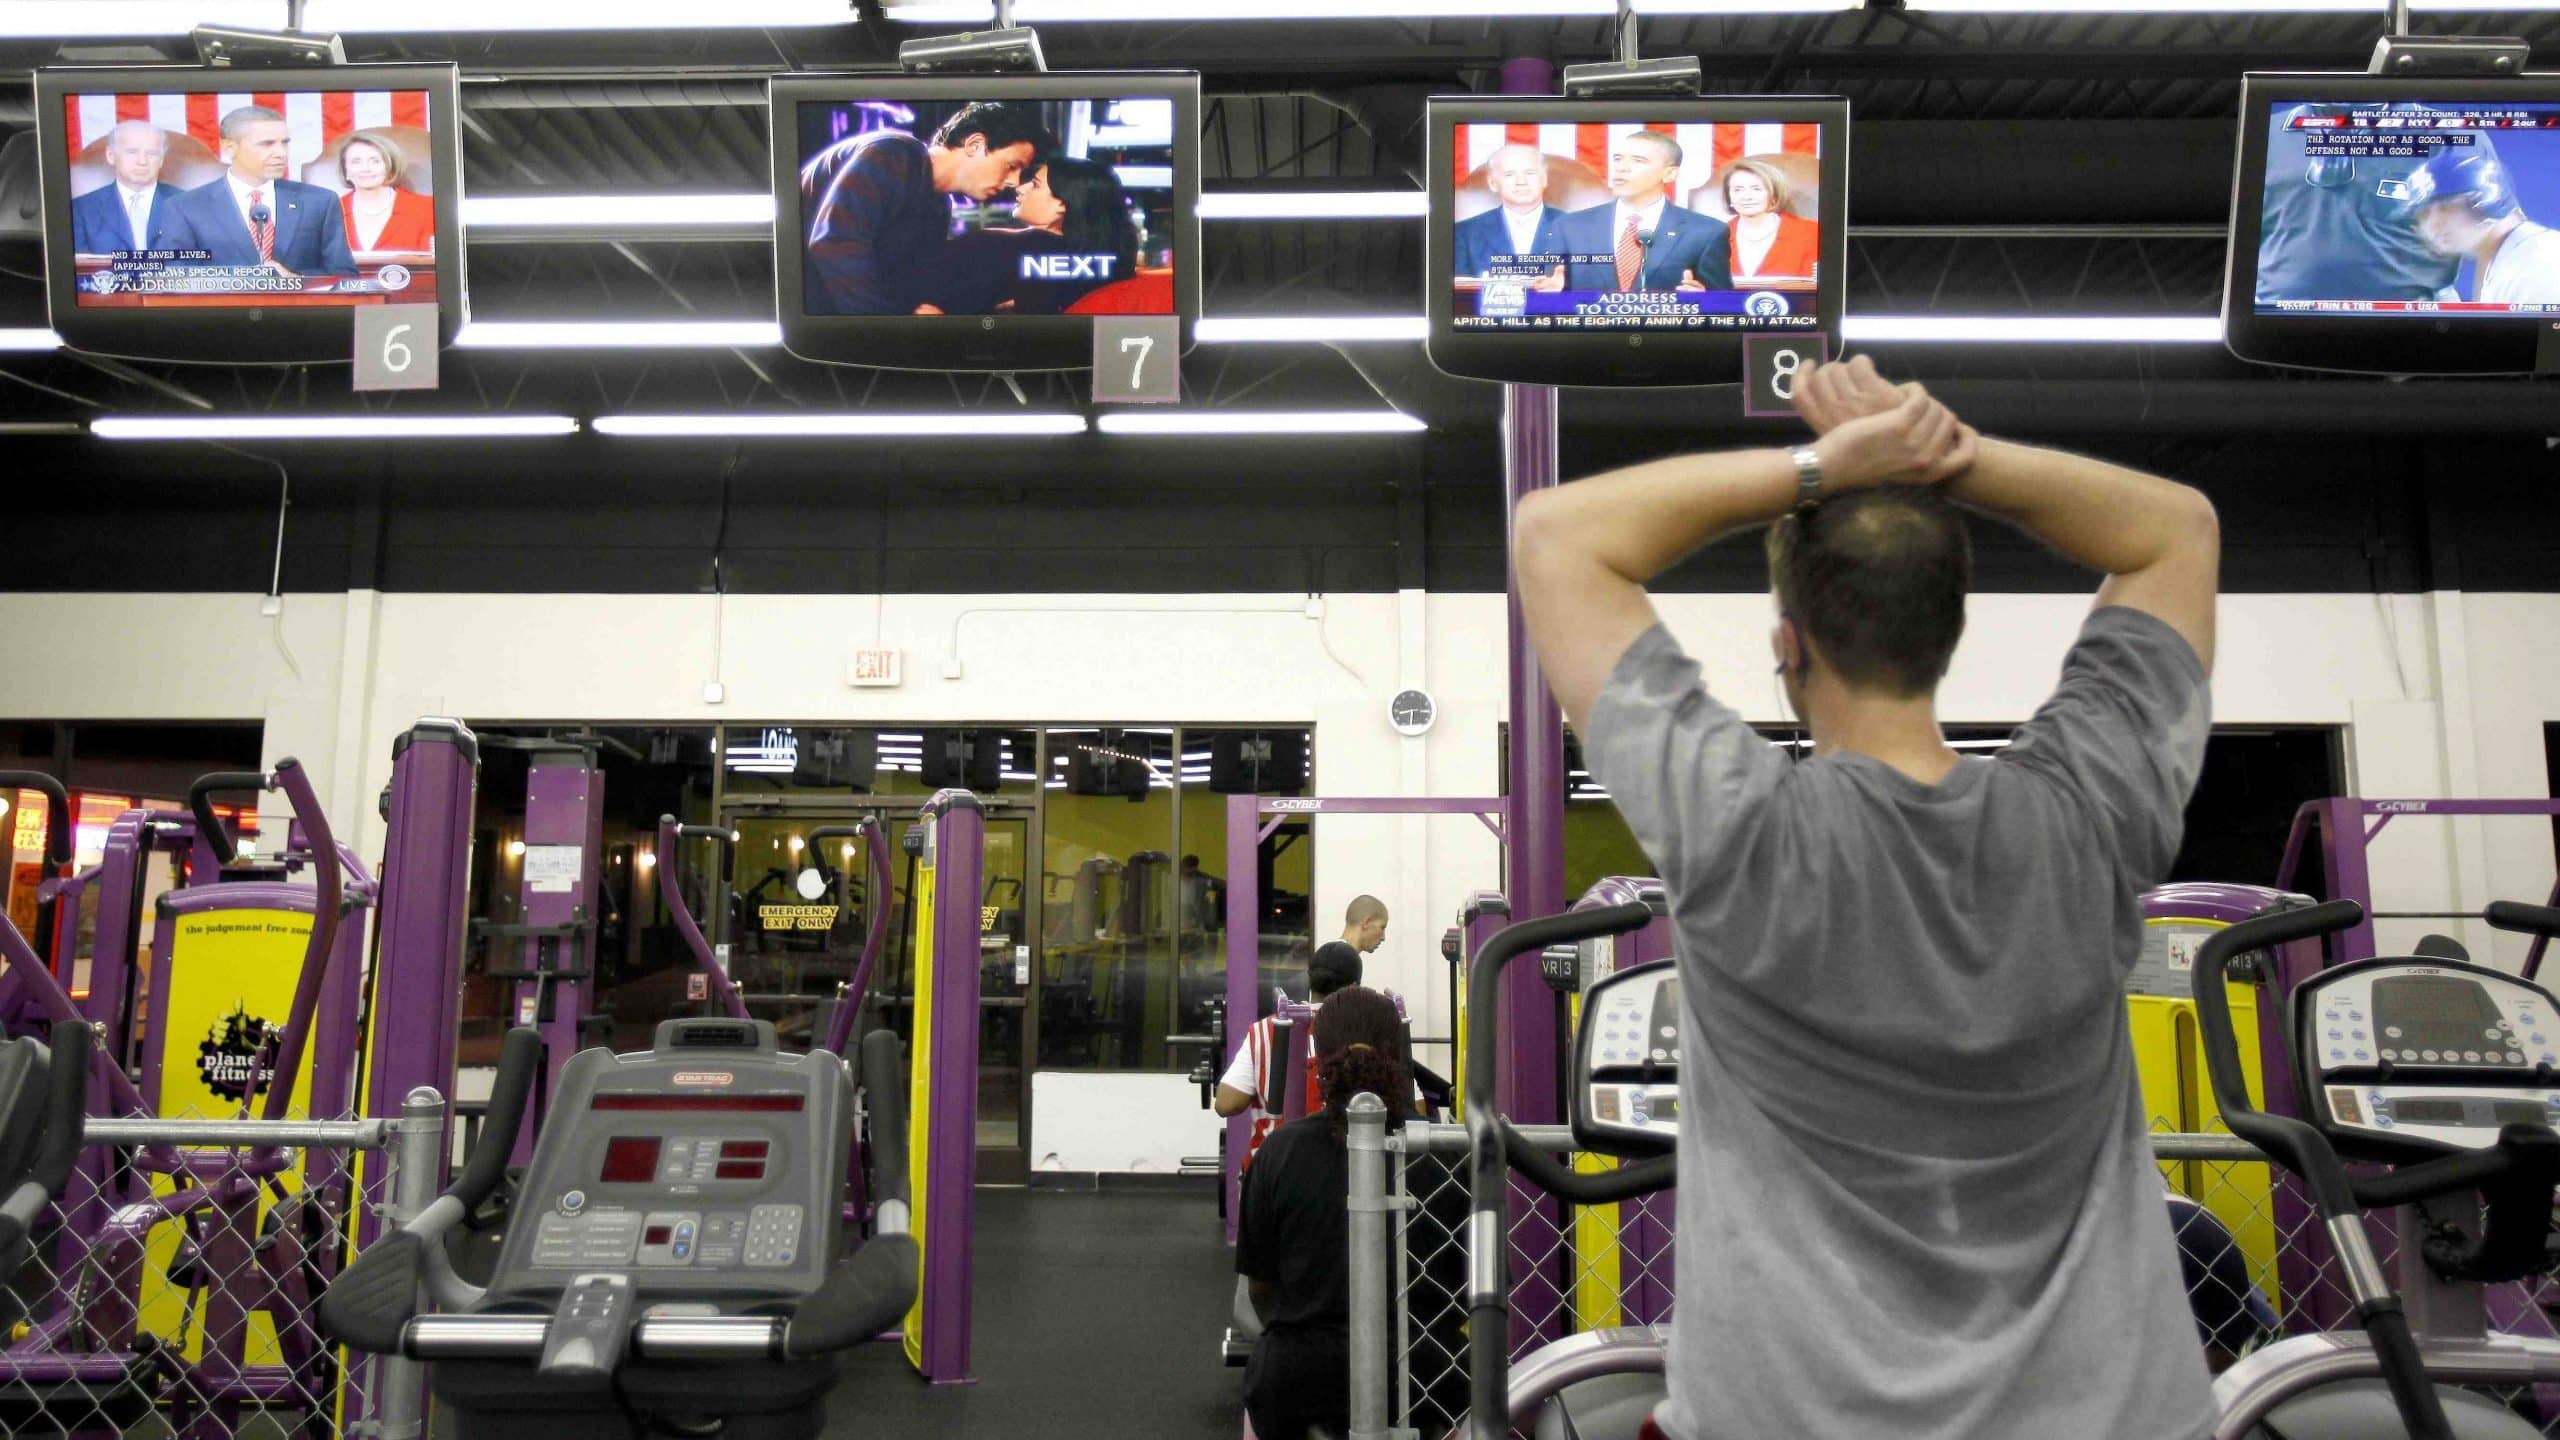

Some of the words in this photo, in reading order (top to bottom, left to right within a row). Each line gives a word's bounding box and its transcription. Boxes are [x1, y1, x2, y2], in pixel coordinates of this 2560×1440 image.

[2408, 118, 2431, 127] NYY
[2307, 135, 2324, 144] THE
[2329, 135, 2374, 144] ROTATION
[2379, 135, 2397, 144] NOT
[2401, 136, 2413, 144] AS
[2418, 136, 2445, 145] GOOD,
[2452, 136, 2470, 144] THE
[2305, 146, 2345, 155] OFFENSE
[2350, 146, 2368, 155] NOT
[2372, 147, 2384, 155] AS
[2389, 147, 2413, 155] GOOD
[112, 250, 128, 260] AND
[134, 251, 143, 260] IT
[148, 250, 175, 260] SAVES
[1490, 255, 1513, 263] MORE
[1570, 255, 1588, 263] AND
[1592, 255, 1614, 263] MORE
[113, 262, 164, 271] (APPLAUSE)
[1022, 254, 1117, 278] NEXT
[188, 268, 231, 278] SPECIAL
[235, 267, 274, 278] REPORT
[120, 278, 190, 292] ADDRESS
[195, 278, 220, 292] TO
[219, 277, 303, 292] CONGRESS
[339, 280, 368, 289] LIVE
[1598, 292, 1677, 304] ADDRESS
[1576, 303, 1601, 315] TO
[1606, 303, 1699, 315] CONGRESS
[2418, 303, 2440, 311] USA
[1502, 317, 1531, 326] HILL
[1533, 317, 1551, 326] AS
[1556, 317, 1580, 326] THE
[1585, 316, 1641, 326] EIGHT-YR
[1645, 316, 1684, 326] ANNIV
[1688, 316, 1706, 326] OF
[1711, 316, 1735, 326] THE
[1738, 316, 1764, 327] 9/11
[1769, 316, 1817, 325] ATTACK
[383, 323, 412, 373] 6
[1120, 335, 1155, 390] 7
[1771, 348, 1800, 400] 8
[856, 649, 896, 680] EXIT
[759, 905, 839, 917] EMERGENCY
[763, 917, 794, 929] EXIT
[797, 917, 834, 929] ONLY
[186, 924, 203, 935] the
[205, 923, 262, 936] judgement
[266, 923, 288, 934] free
[204, 1051, 264, 1071] plane
